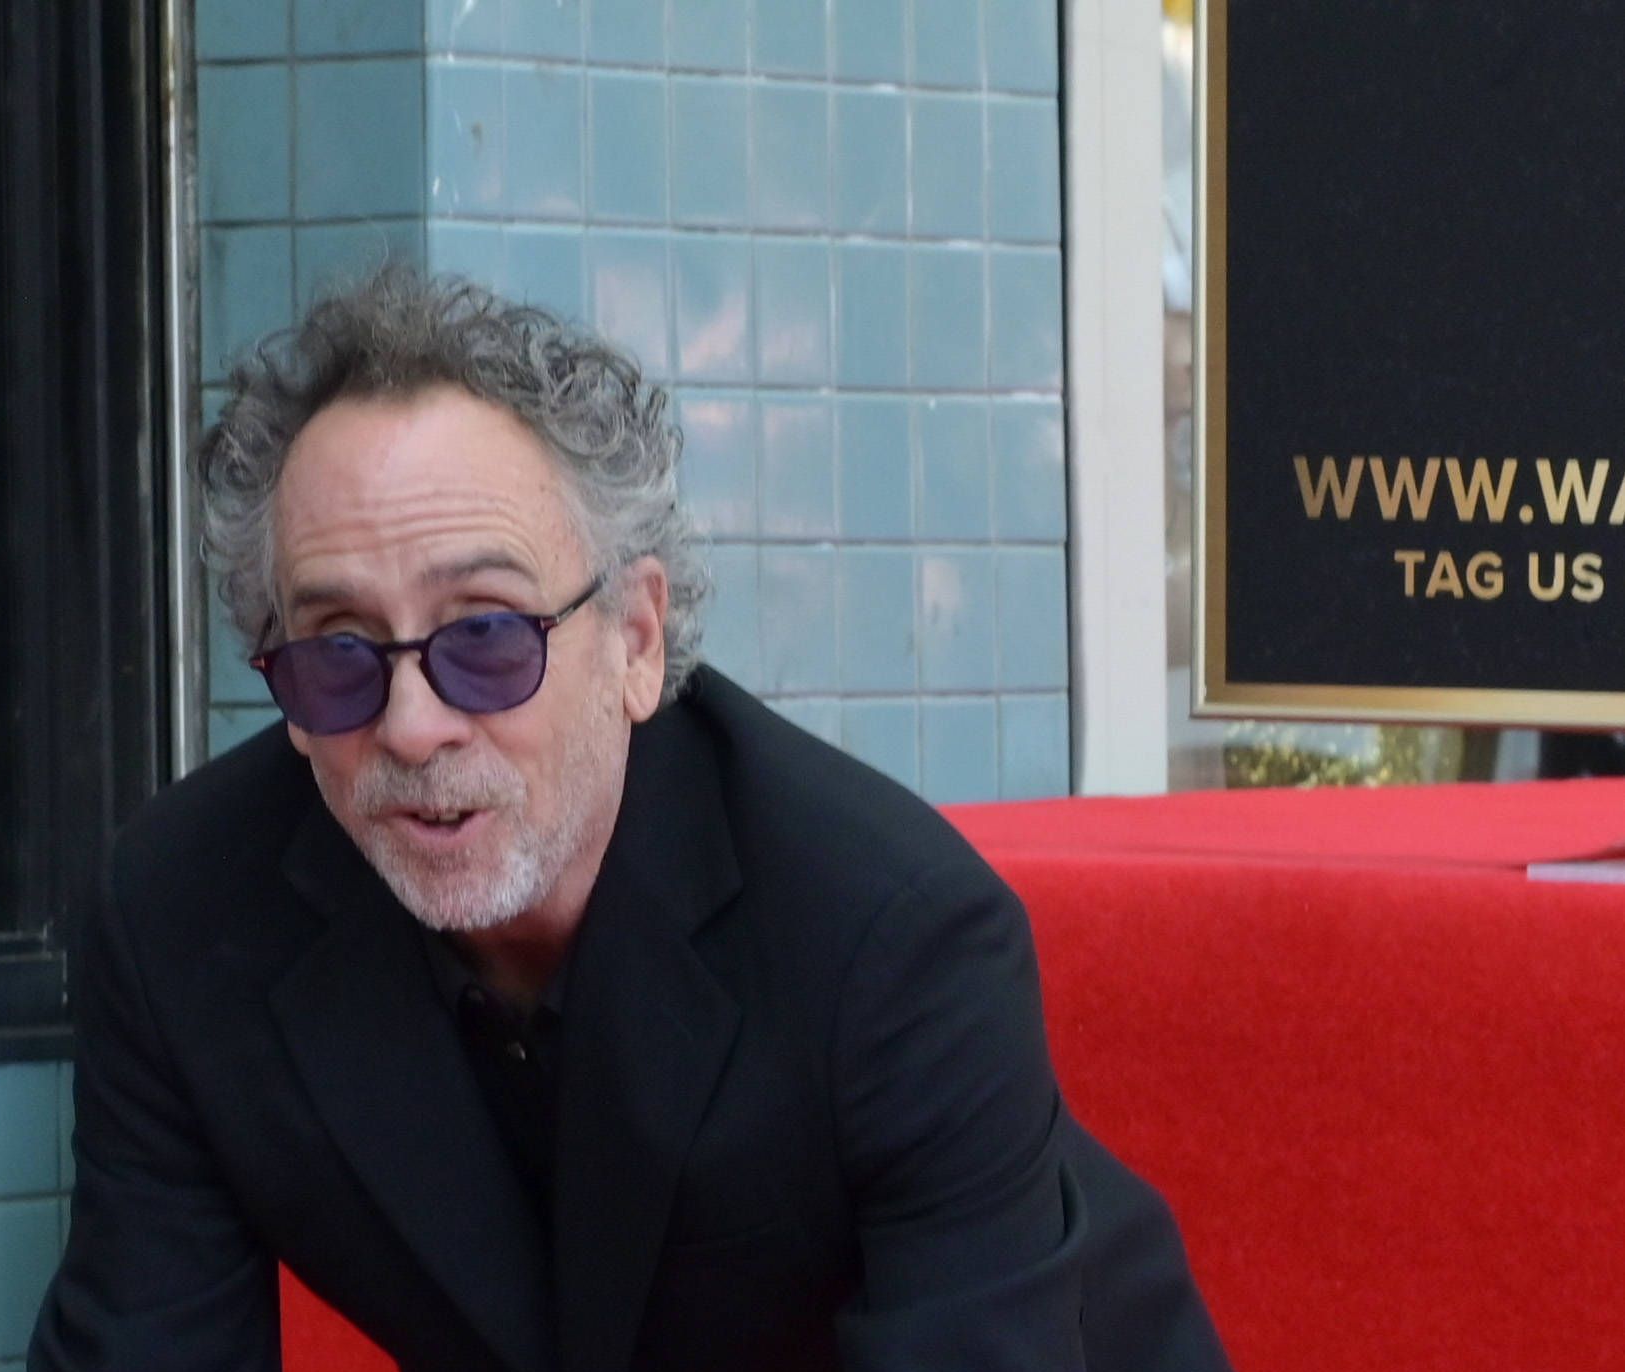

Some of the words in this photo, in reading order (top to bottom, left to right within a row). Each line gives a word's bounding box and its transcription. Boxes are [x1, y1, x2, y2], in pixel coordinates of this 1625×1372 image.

[1293, 454, 1625, 526] WWW.W
[1393, 549, 1505, 601] TAG
[1527, 551, 1605, 603] US
